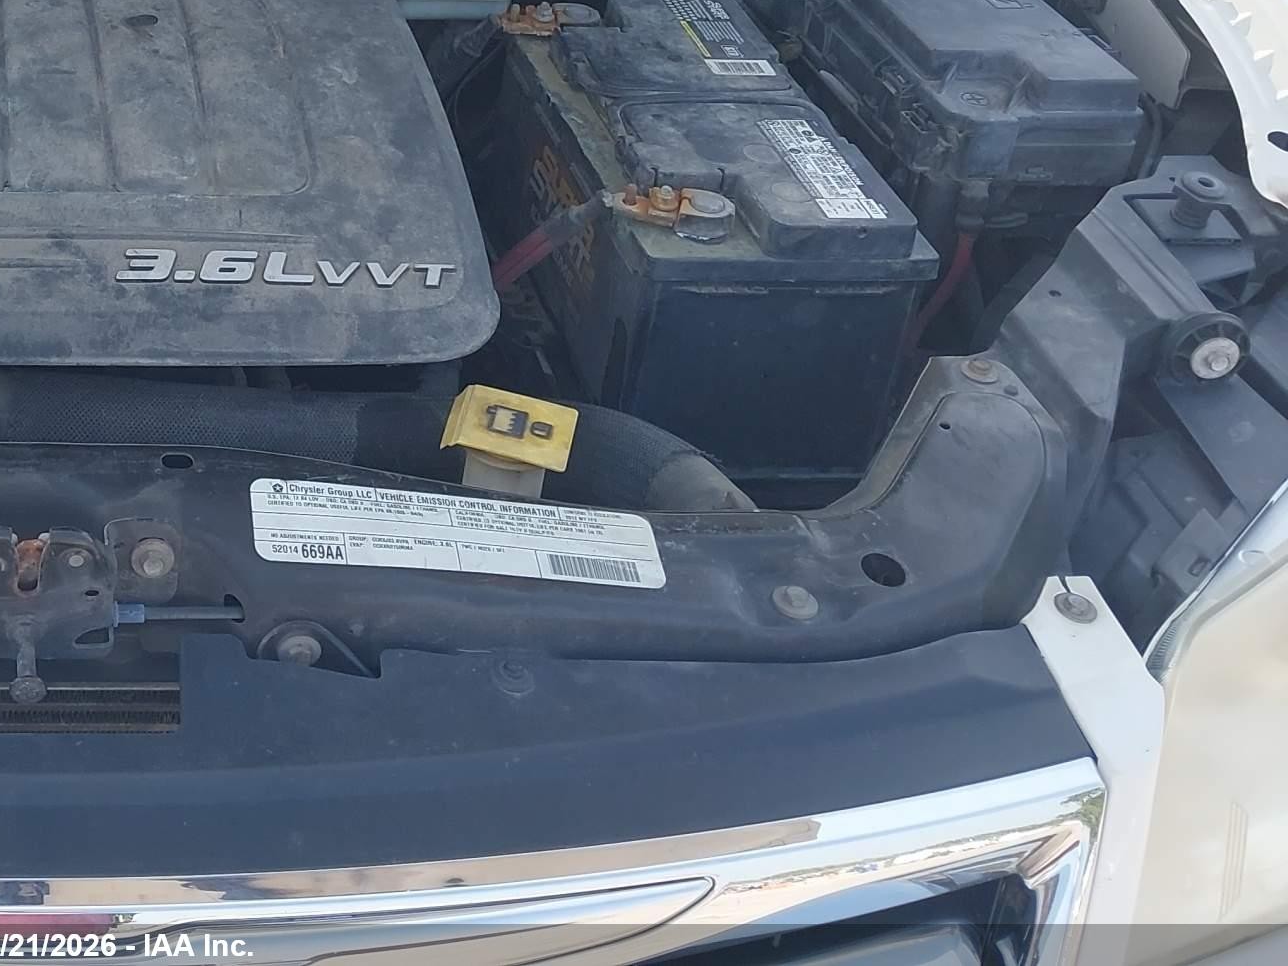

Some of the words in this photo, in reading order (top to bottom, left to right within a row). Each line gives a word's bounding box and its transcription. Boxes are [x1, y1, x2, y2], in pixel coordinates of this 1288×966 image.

[288, 483, 324, 495] Chrysler
[327, 486, 352, 498] Group
[355, 489, 372, 498] LLC
[378, 492, 414, 503] VEHICLE
[416, 495, 456, 507] EMISSION
[458, 500, 496, 511] CONTROL
[499, 504, 555, 517] INFORMATION
[271, 544, 298, 554] 52014
[300, 543, 344, 560] 669AA
